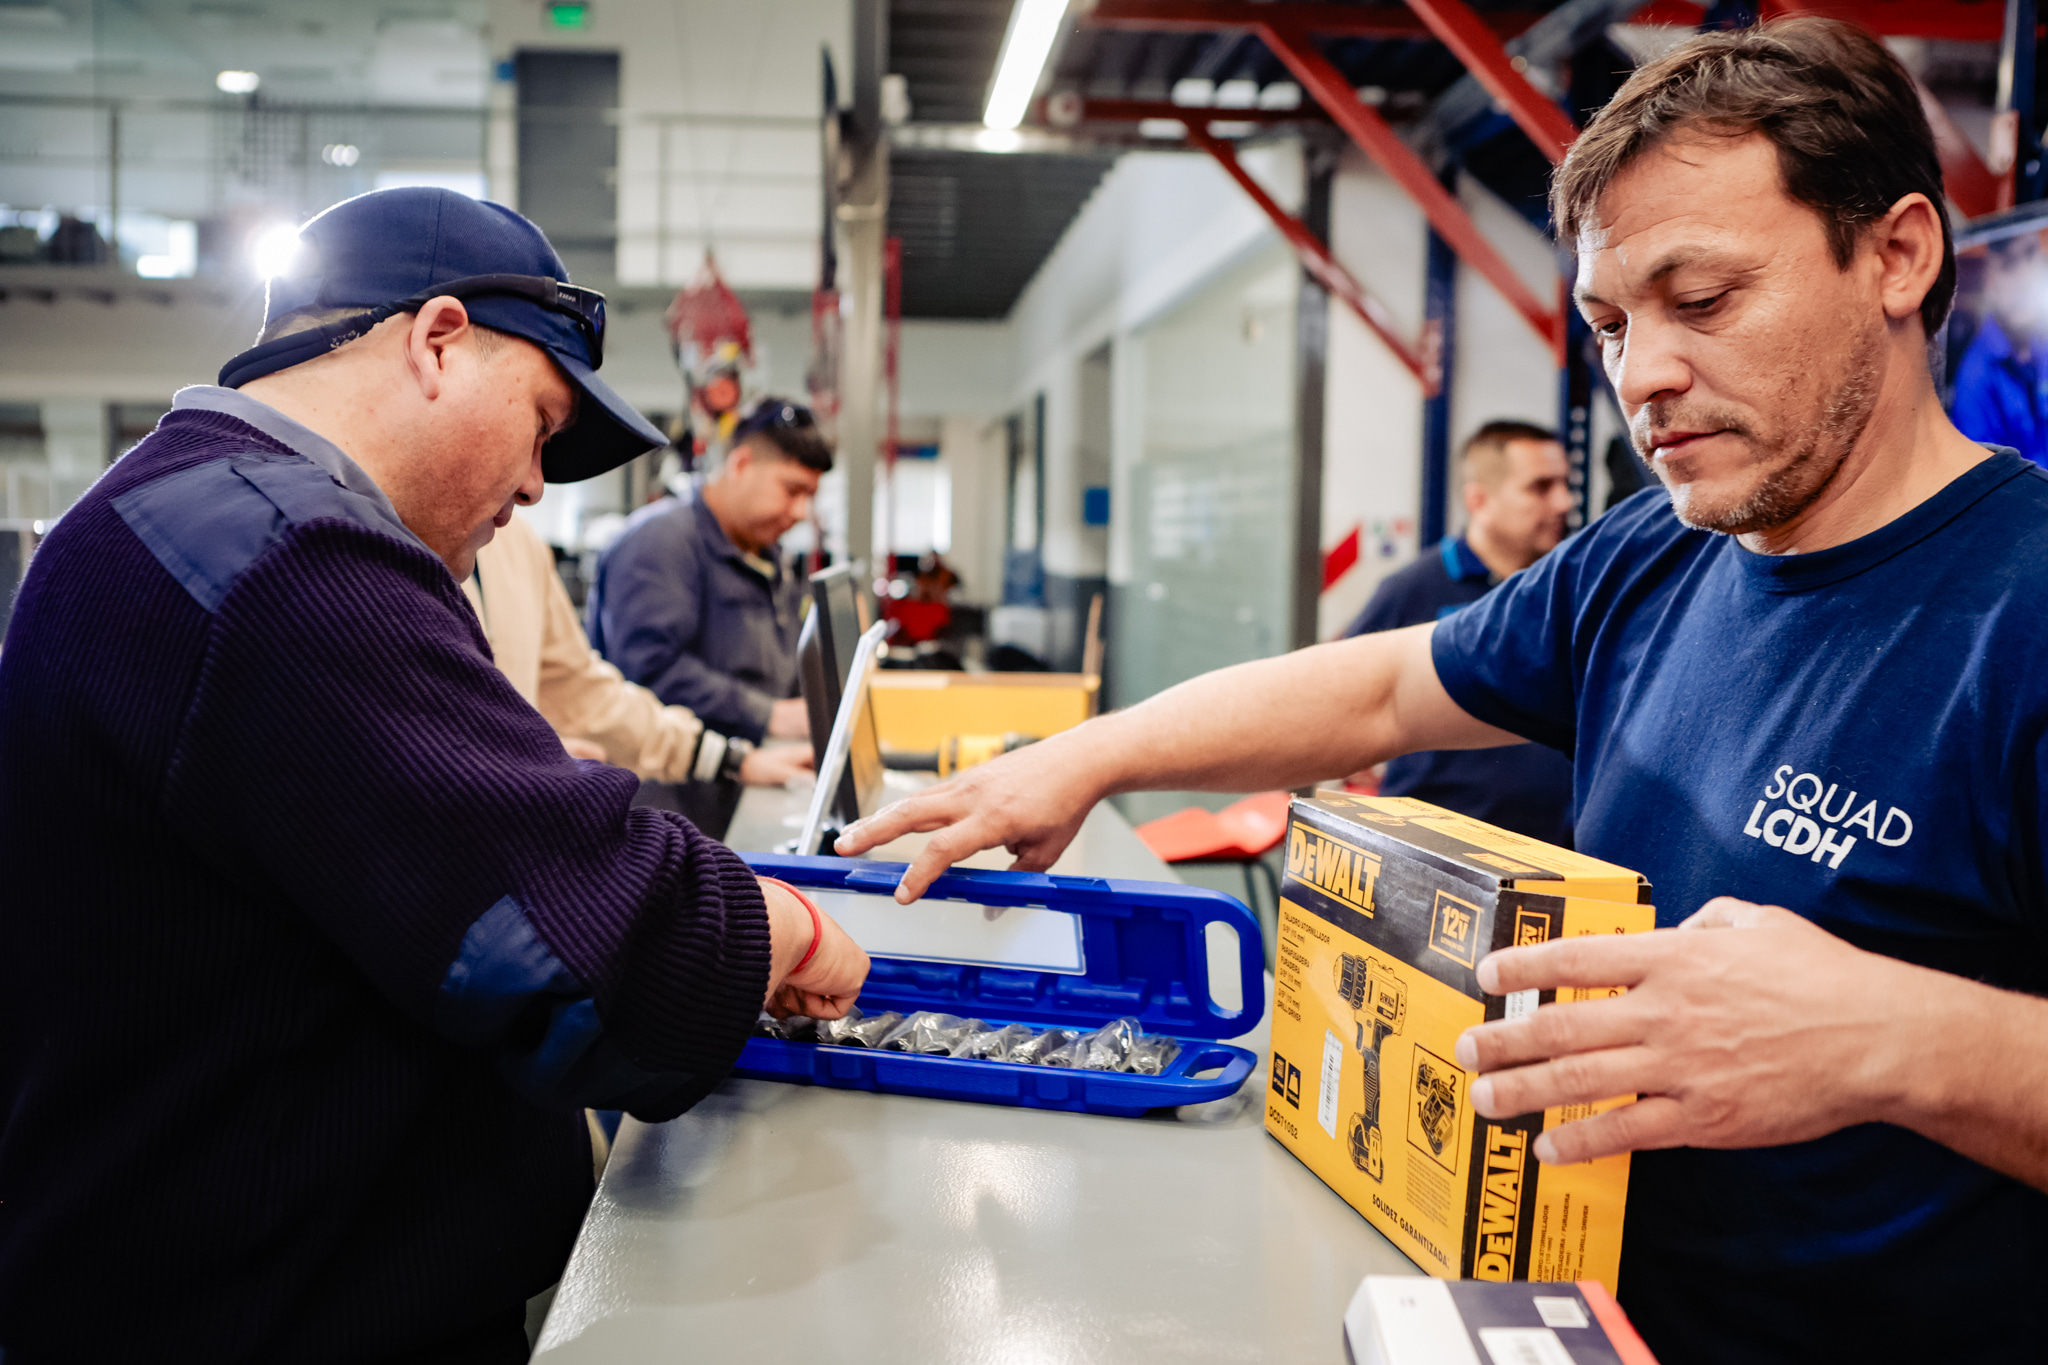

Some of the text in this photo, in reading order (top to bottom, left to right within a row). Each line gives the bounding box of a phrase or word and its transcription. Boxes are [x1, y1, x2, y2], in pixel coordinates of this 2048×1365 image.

[1764, 764, 1914, 848] SQUAD
[1742, 799, 1858, 871] LCDH
[1520, 923, 1539, 947] 2V
[1449, 1074, 1457, 1093] 2
[1372, 1193, 1398, 1225] SOLIDEZ
